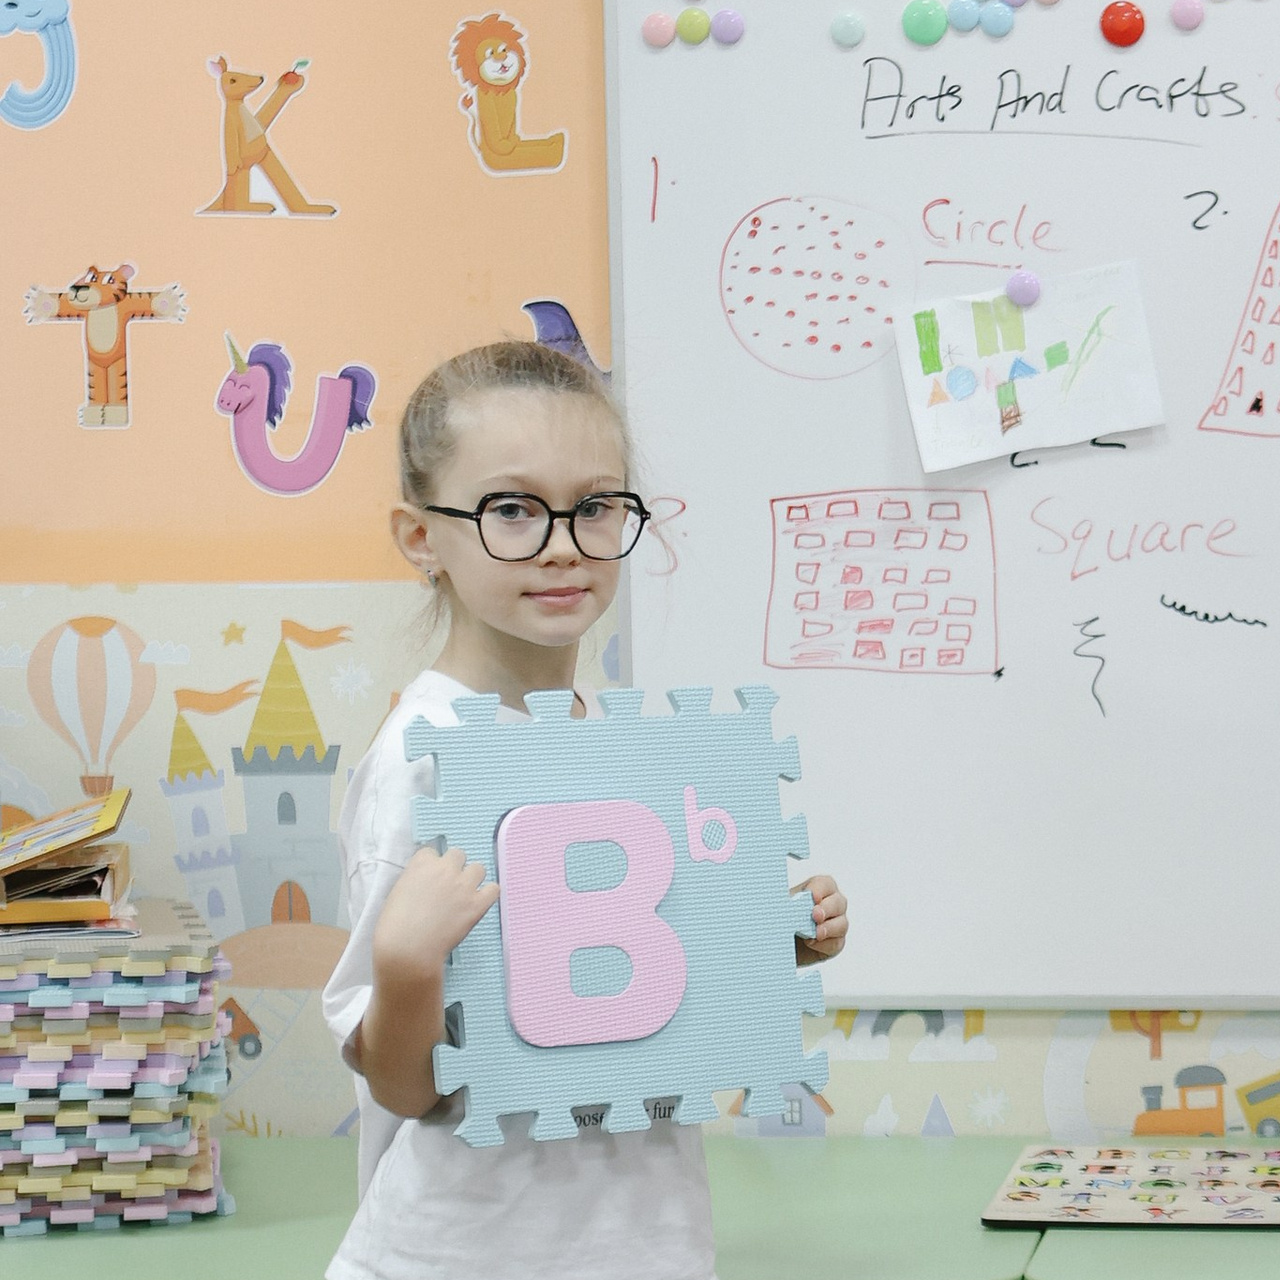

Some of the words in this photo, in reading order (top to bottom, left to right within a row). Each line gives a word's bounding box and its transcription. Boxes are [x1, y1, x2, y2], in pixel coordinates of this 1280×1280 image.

[196, 56, 341, 217] K
[450, 12, 568, 175] L
[861, 56, 964, 130] Arts
[990, 64, 1072, 132] And
[922, 198, 1063, 252] Circle
[24, 263, 188, 427] T
[216, 332, 378, 496] U
[1031, 497, 1253, 581] Square
[495, 800, 688, 1048] B
[684, 785, 739, 865] b
